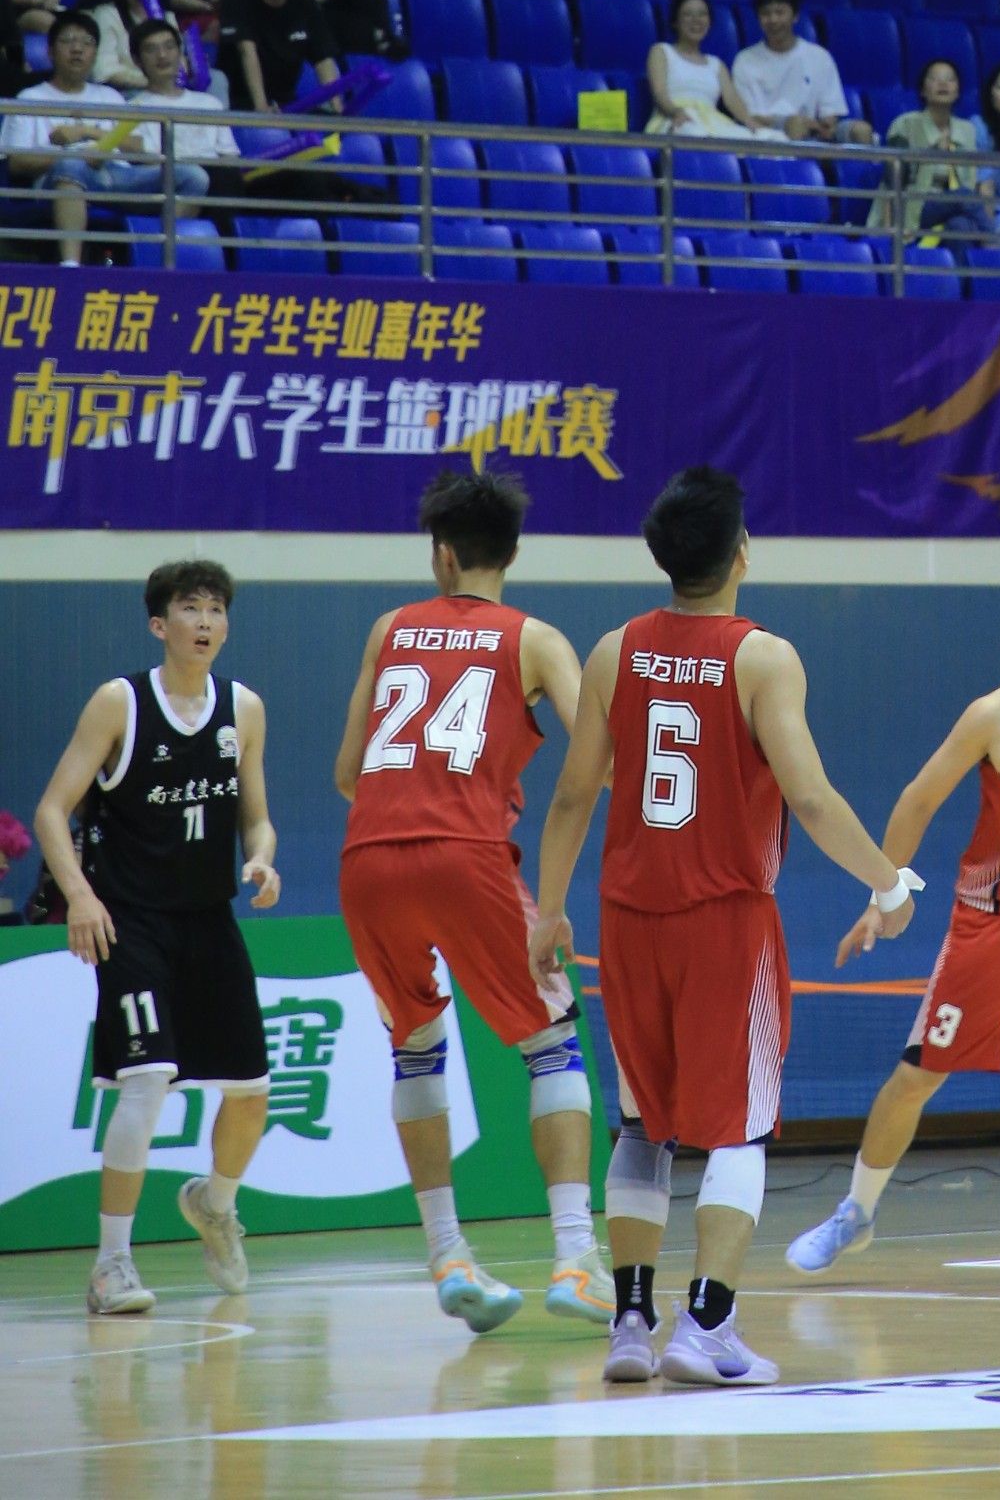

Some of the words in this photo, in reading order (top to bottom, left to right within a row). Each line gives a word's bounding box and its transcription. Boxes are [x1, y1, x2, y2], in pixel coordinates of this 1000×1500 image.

[6, 357, 624, 495] 南京市大学生篮球联赛
[391, 627, 504, 652] 有迈体育
[361, 664, 497, 776] 24
[641, 698, 701, 830] 6
[183, 804, 205, 842] 11
[119, 990, 160, 1036] 11
[927, 1002, 963, 1049] 3
